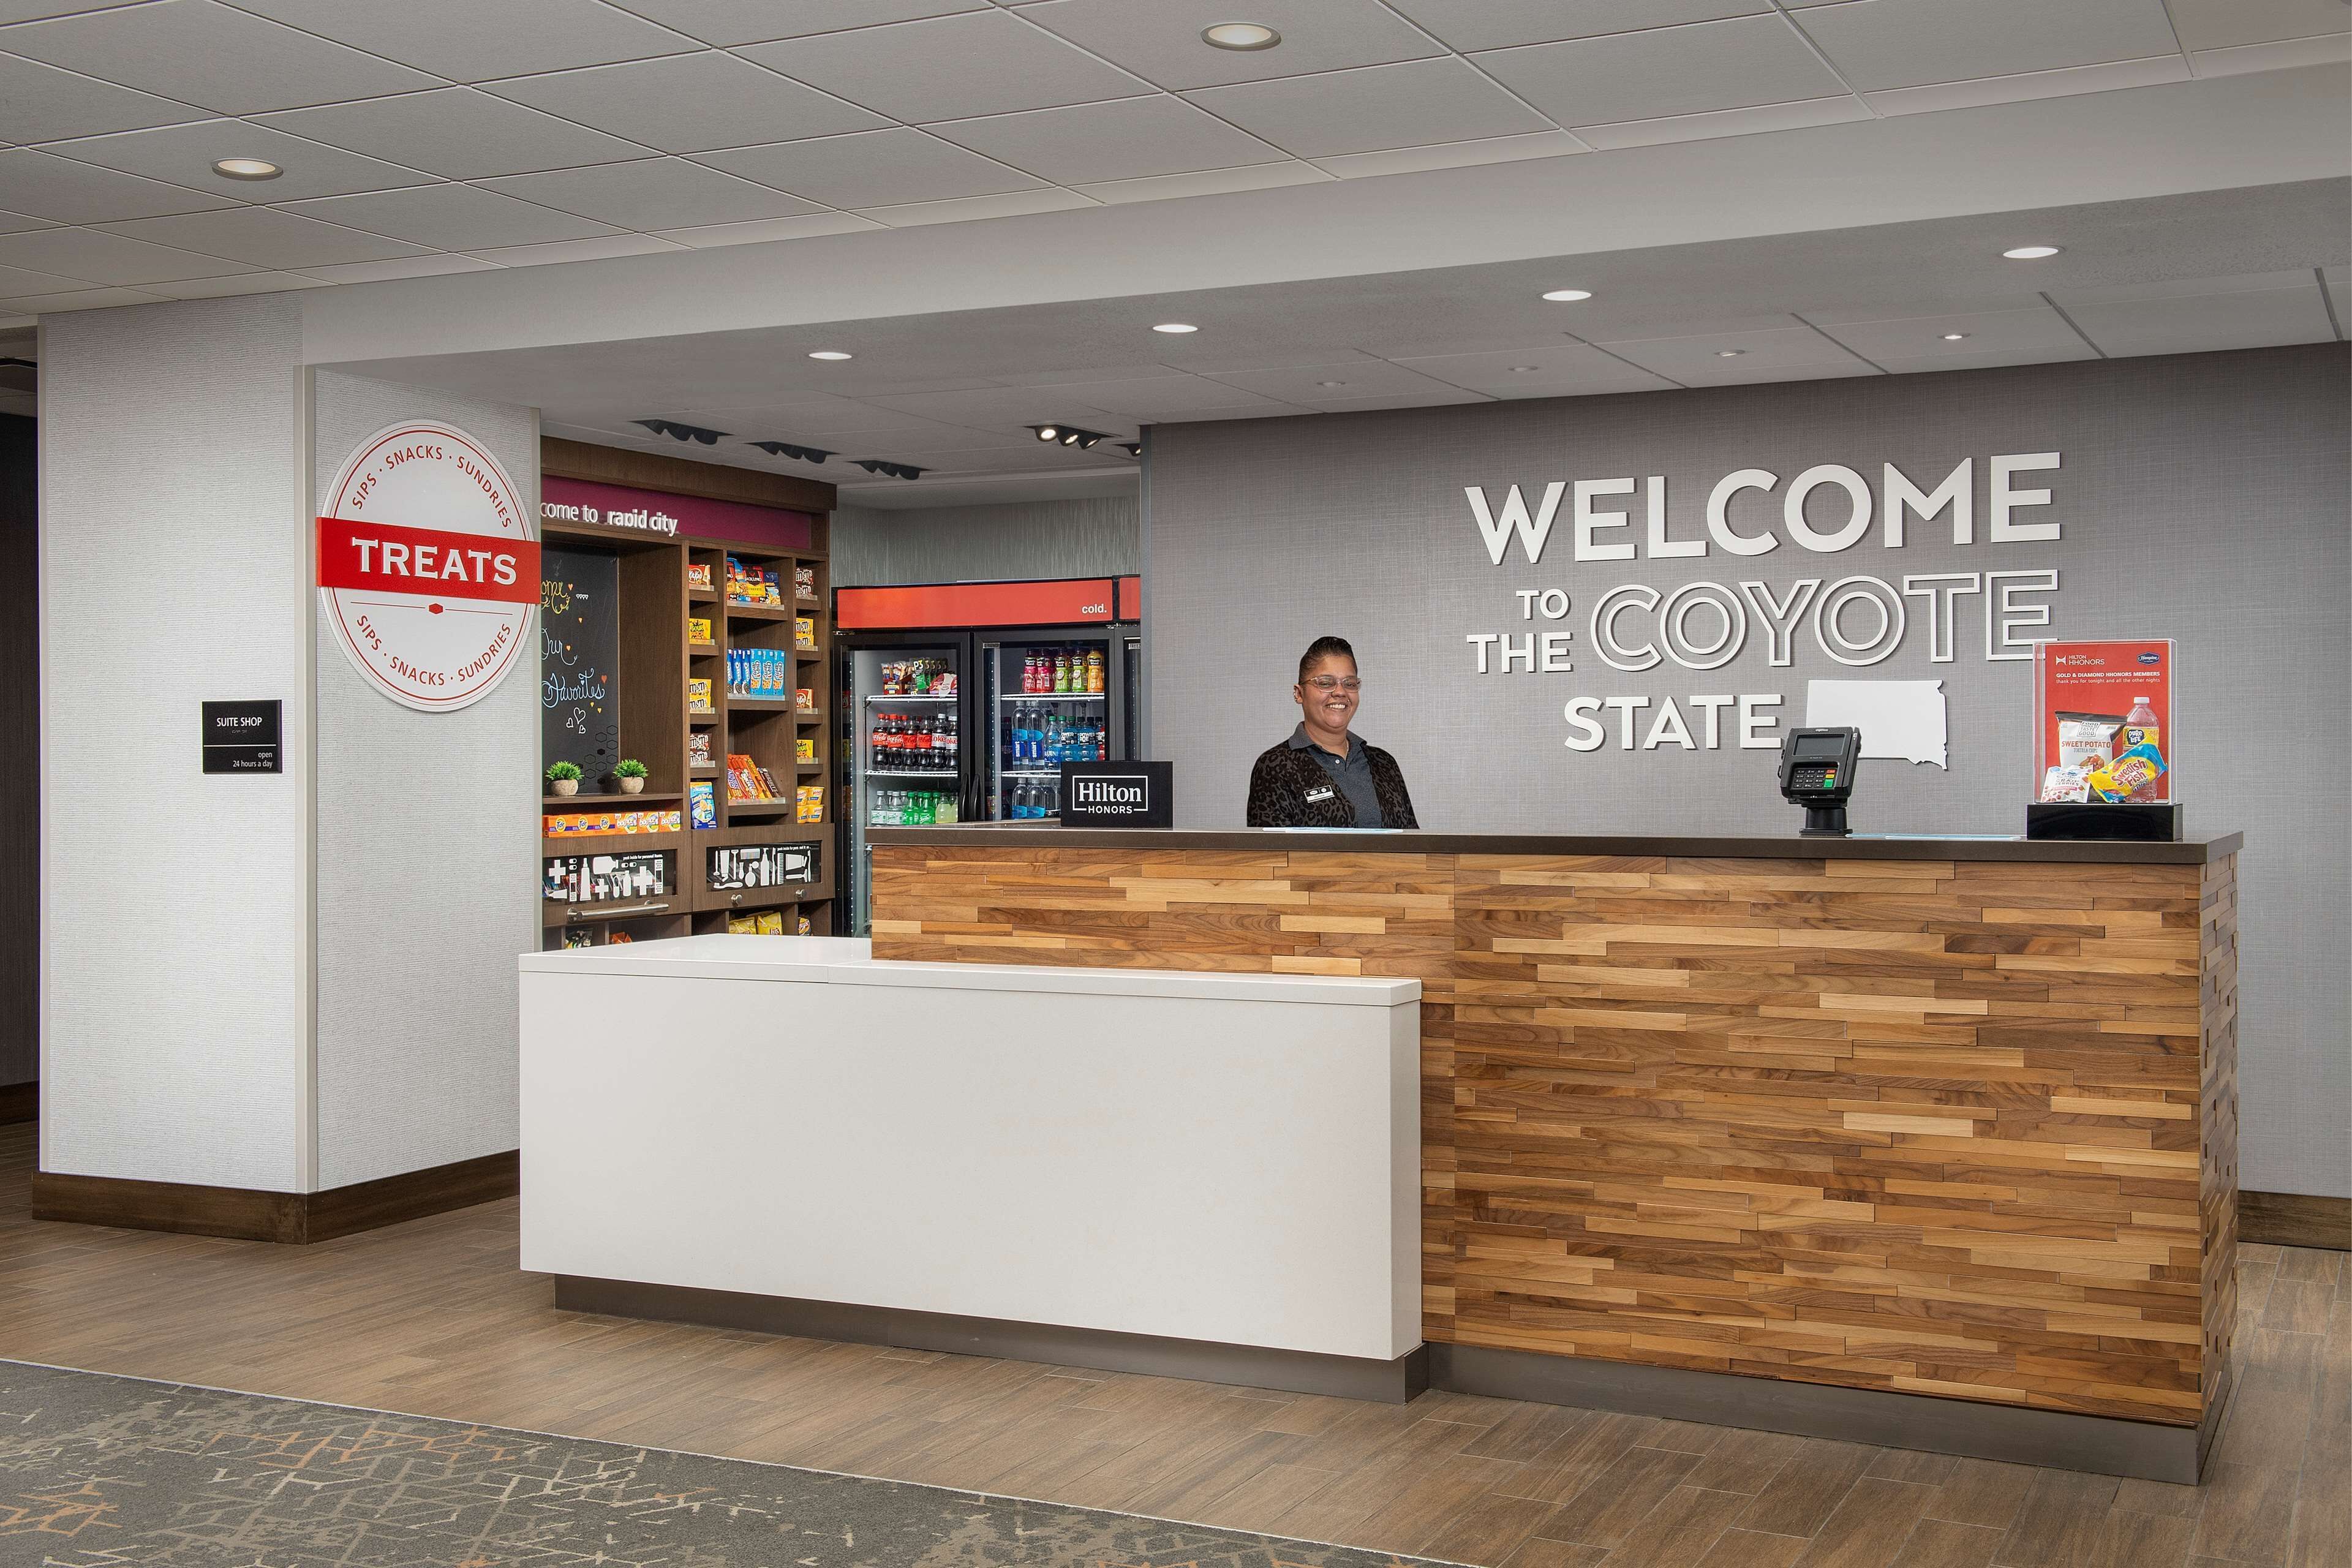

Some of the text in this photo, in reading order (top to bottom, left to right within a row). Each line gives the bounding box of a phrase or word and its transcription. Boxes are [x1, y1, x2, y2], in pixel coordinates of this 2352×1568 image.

[352, 445, 511, 529] SIPS SNACKS SUNDRIES
[581, 504, 598, 522] to
[649, 511, 678, 537] city
[1464, 451, 2060, 565] WELCOME
[352, 537, 517, 586] TREATS
[1082, 603, 1107, 614] cold.
[1516, 588, 1569, 620] TO
[1589, 569, 2058, 672] COYOTE
[356, 615, 511, 686] SIPS SNACKS SUNDRIES
[1466, 631, 1572, 673] THE
[216, 717, 263, 727] SUITE SHOP
[1564, 694, 1784, 752] STATE
[262, 760, 273, 769] day
[2111, 759, 2147, 787] Swedish
[2124, 771, 2147, 787] Fish
[1079, 783, 1142, 802] Hilton
[1088, 805, 1133, 814] HONORS
